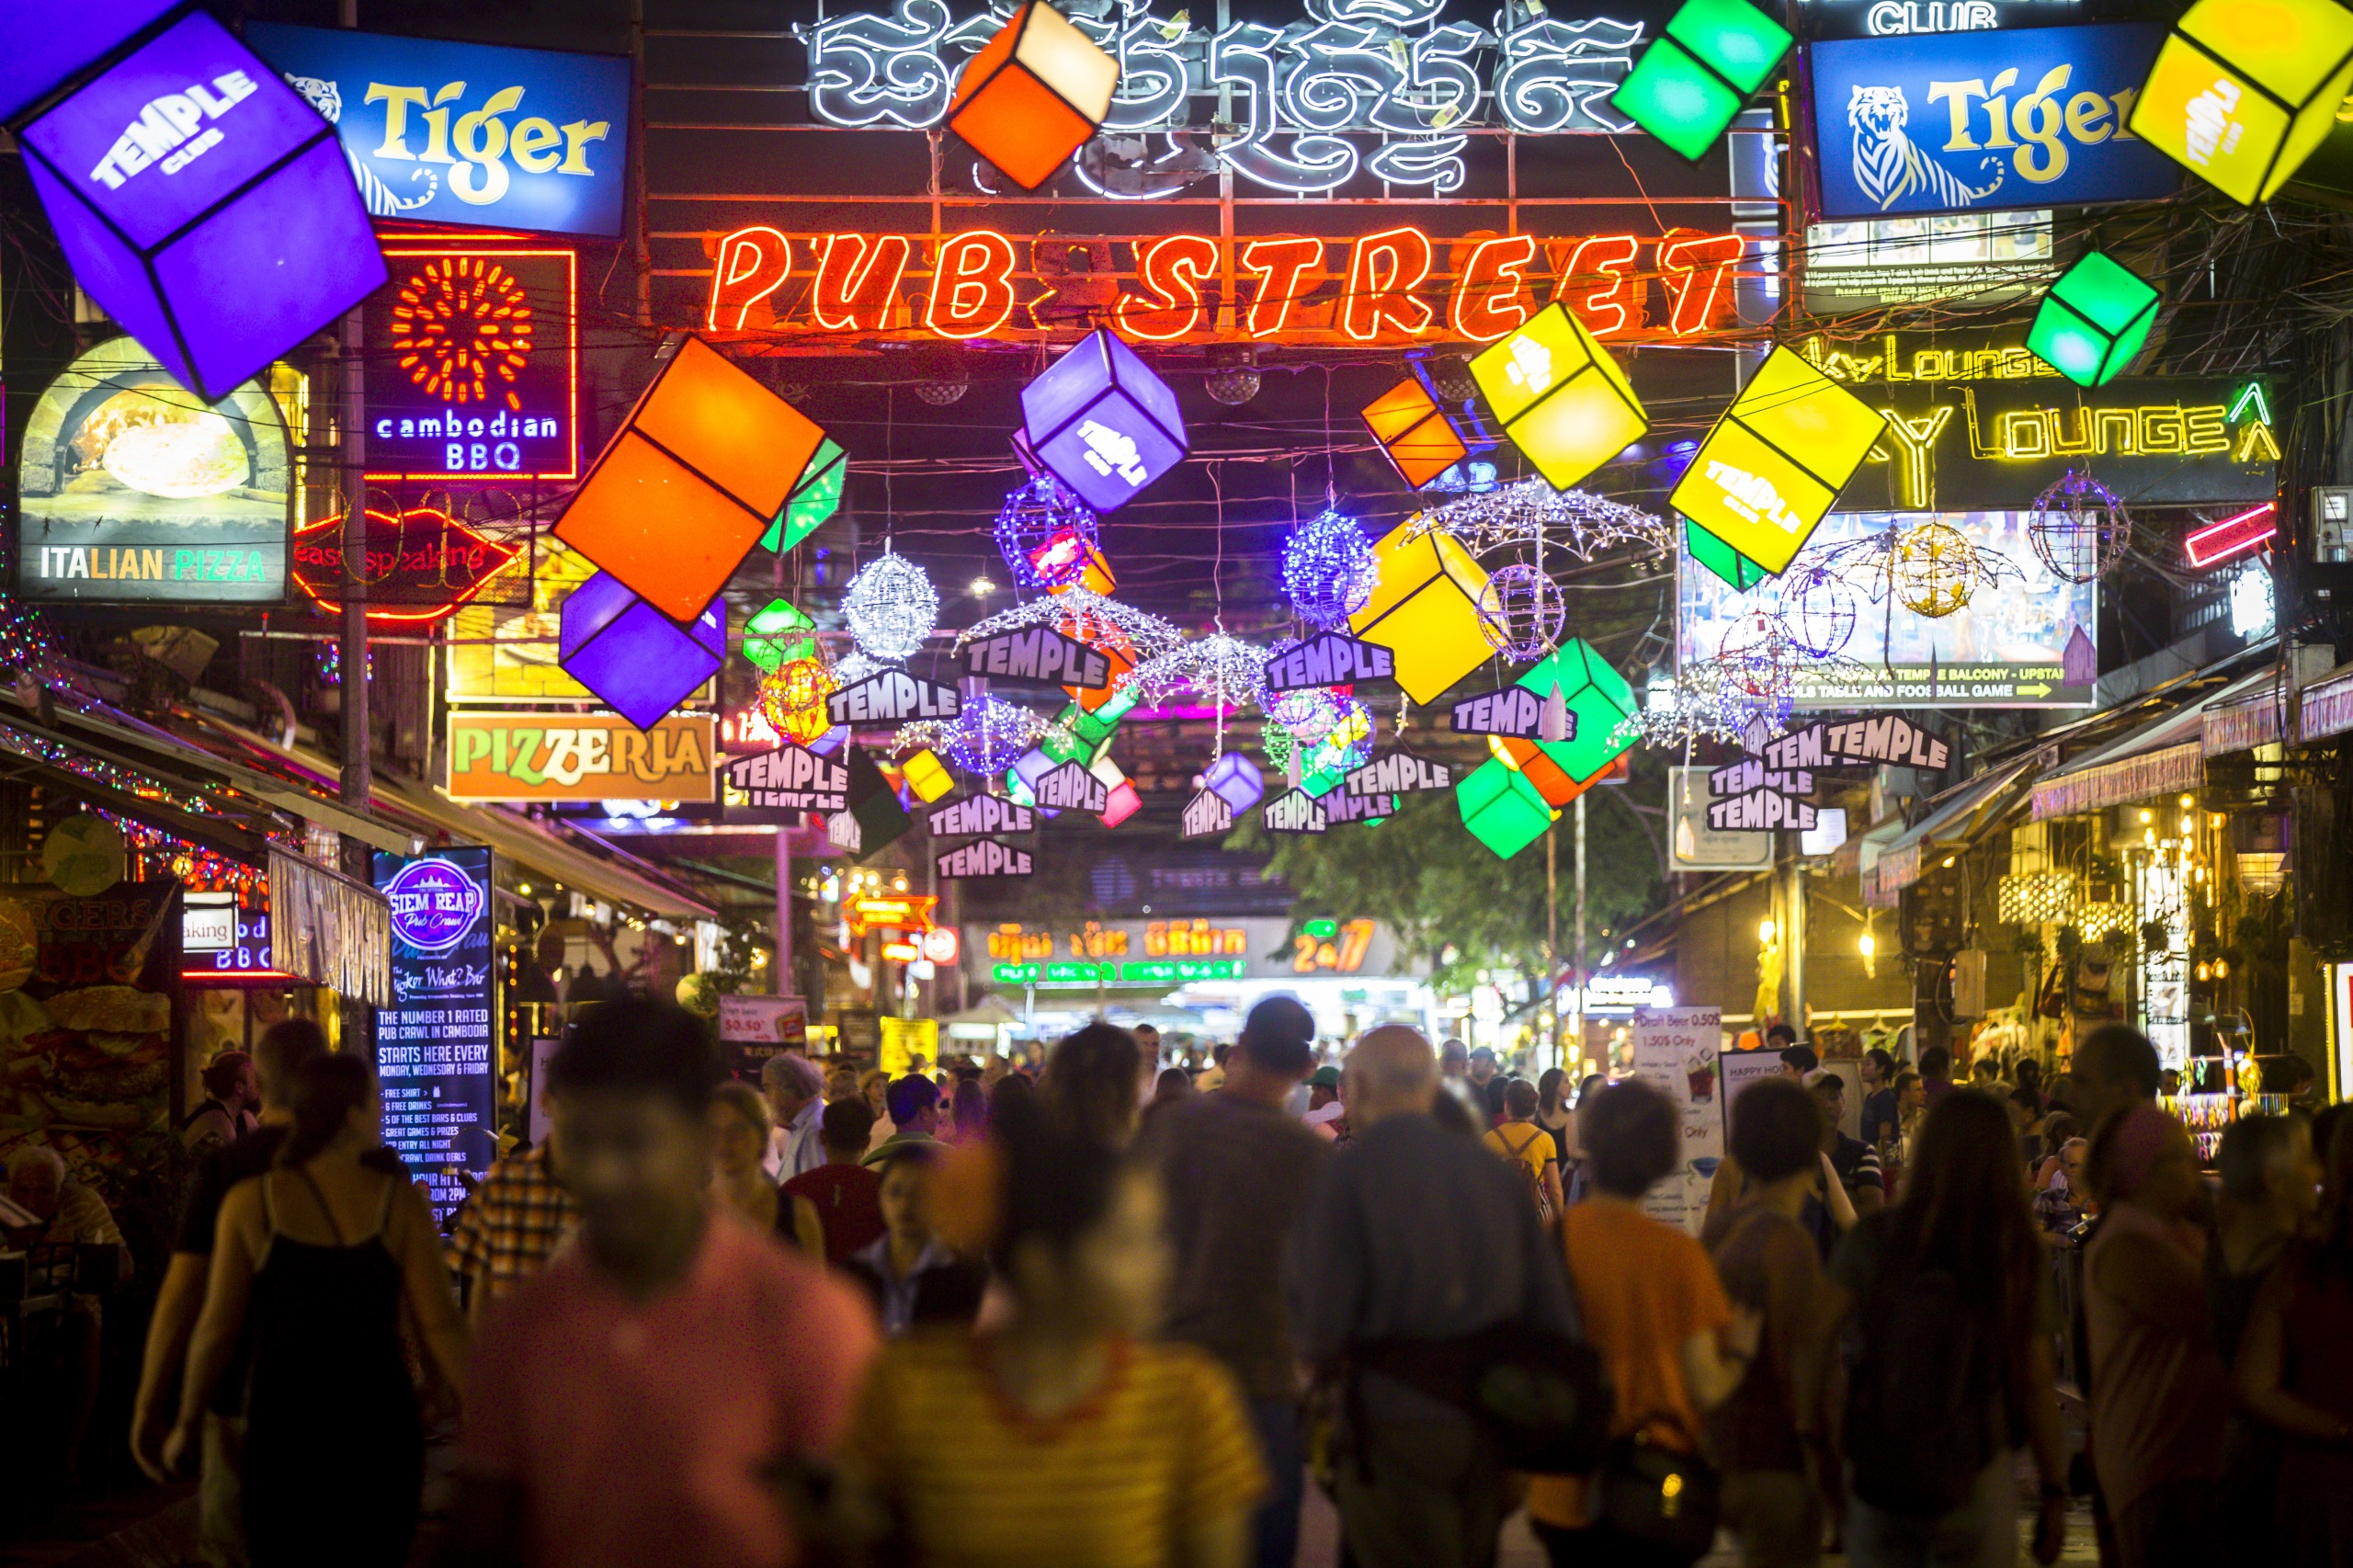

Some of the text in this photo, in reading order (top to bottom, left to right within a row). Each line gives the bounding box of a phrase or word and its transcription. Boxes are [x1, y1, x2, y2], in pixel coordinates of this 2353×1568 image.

[1868, 1, 1997, 35] CLUB
[90, 69, 258, 191] TEMPLE
[364, 81, 610, 205] Tiger
[160, 128, 224, 176] CLUB
[707, 226, 1745, 346] PUB STREET
[377, 409, 557, 437] cambodian
[1965, 386, 2230, 460] LOUNGE
[446, 441, 520, 472] BBQ
[1705, 460, 1802, 535] TEMPLE
[40, 547, 266, 582] ITALIAN PIZZA
[968, 628, 1106, 685] TEMPLE
[1267, 636, 1393, 688] TEMPLE
[1818, 685, 1862, 699] TABLE
[1863, 685, 1894, 699] AND
[1972, 684, 2014, 698] GAME
[1896, 668, 1947, 681] TEMPE
[1949, 668, 2009, 681] BALCONY
[828, 670, 957, 724] TEMPLE
[454, 728, 708, 787] PIZZERIA
[1827, 715, 1949, 769] TEMPLE
[733, 745, 848, 792] TEMPLE
[1346, 753, 1450, 794] TEMPLE
[1038, 763, 1107, 811] TEMPLE
[929, 795, 1032, 835] TEMPLE
[1184, 791, 1232, 836] TEMPLE
[1266, 791, 1325, 831] TEMPLE
[1710, 788, 1816, 829] TEMPLE
[938, 840, 1032, 876] TEMPLE
[390, 892, 476, 916] SIEM REAP
[404, 914, 463, 930] Pub Crawl
[426, 965, 463, 987] What?
[464, 964, 484, 987] Bar
[379, 1009, 488, 1025] THE NUMBER 1 RATED
[379, 1024, 488, 1040] PUB CRAWL IN CAMBODIA
[379, 1044, 488, 1063] STARTS HERE EVERY
[379, 1065, 411, 1077] MONDAY,
[412, 1063, 455, 1076] WEDNESDAY
[463, 1062, 488, 1074] FRIDAY
[1730, 1066, 1762, 1077] HAPPY
[385, 1088, 421, 1098] FREE SHIRT
[392, 1102, 406, 1111] FREE
[408, 1101, 432, 1110] DRINKS
[385, 1115, 390, 1124] 5
[392, 1115, 400, 1124] OF
[402, 1114, 413, 1123] THE
[415, 1113, 430, 1123] BEST
[432, 1113, 449, 1123] BARS
[456, 1112, 478, 1122] CLUBS
[385, 1128, 405, 1137] GREAT
[407, 1127, 429, 1137] GAMES
[437, 1126, 459, 1136] PRIZES
[398, 1141, 417, 1150] ENTRY
[419, 1140, 430, 1150] ALL
[432, 1140, 451, 1149] NIGHT
[401, 1152, 467, 1163] CRAWL DRINK DEALS
[449, 1187, 466, 1201] 2PM
